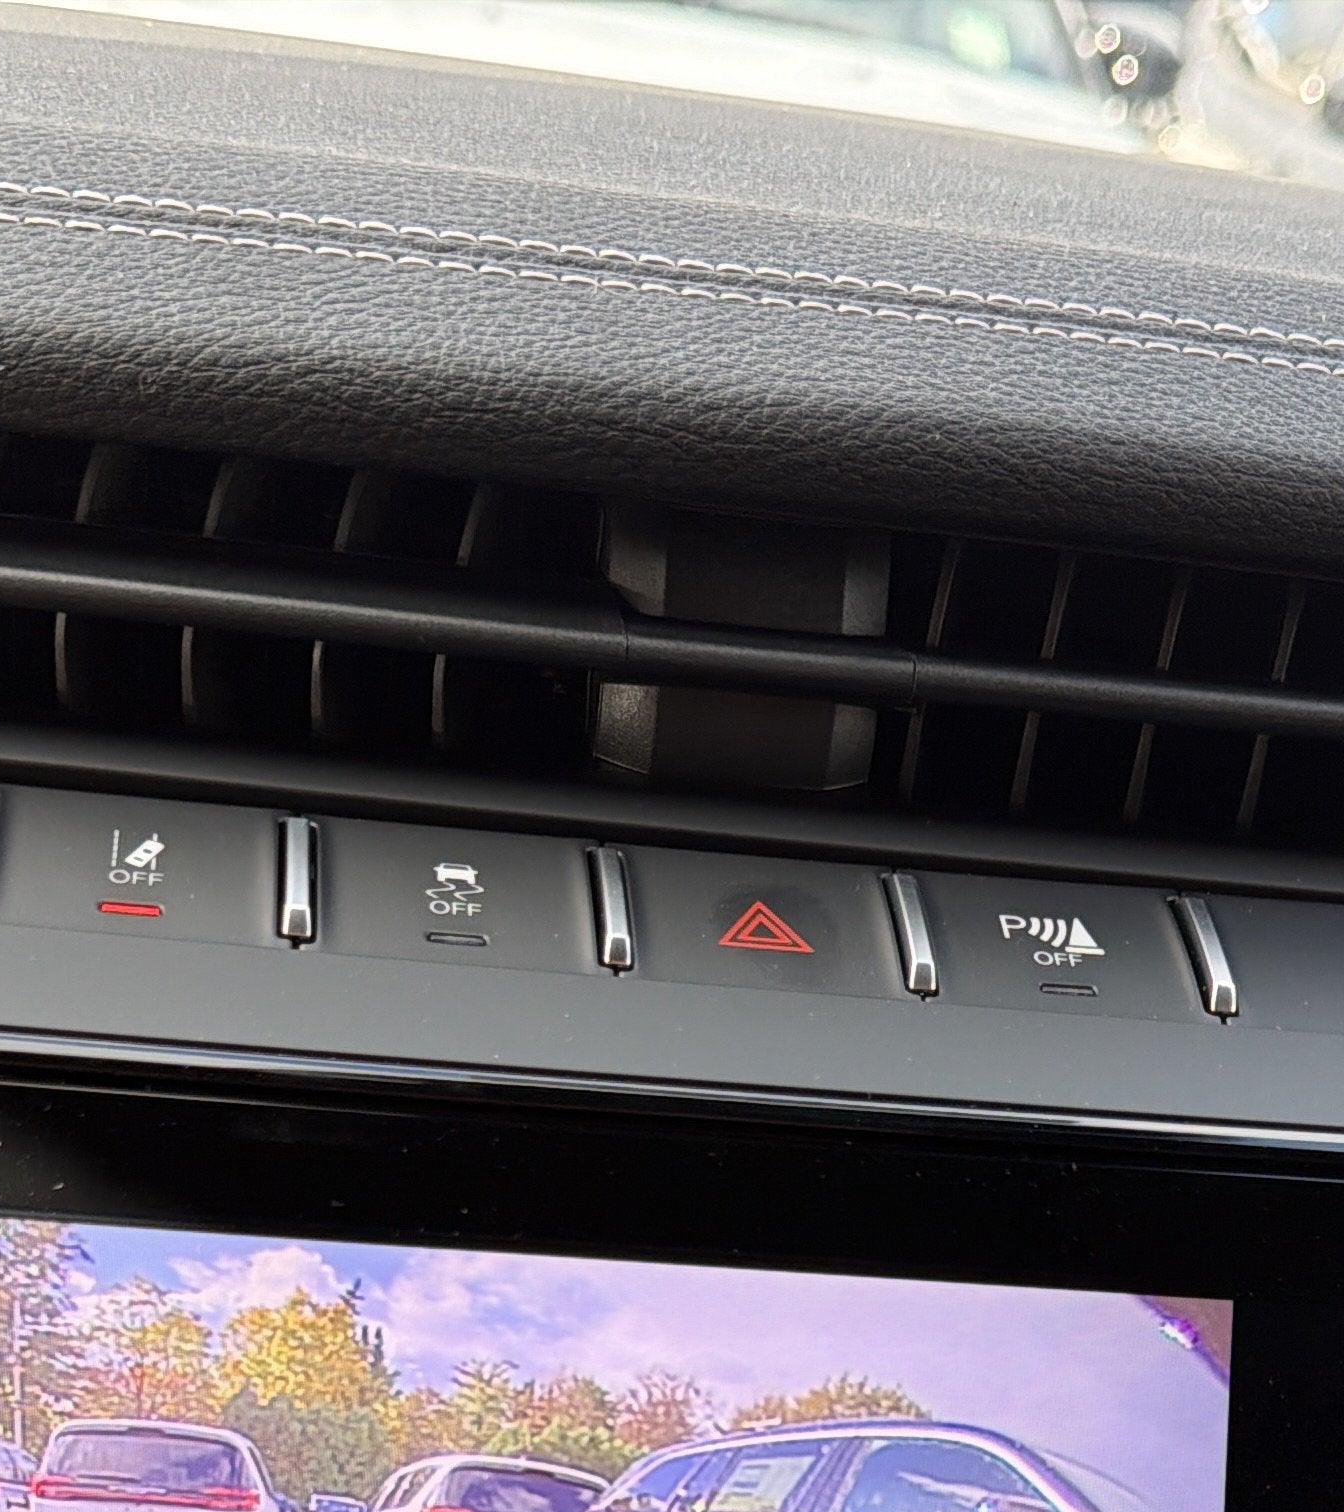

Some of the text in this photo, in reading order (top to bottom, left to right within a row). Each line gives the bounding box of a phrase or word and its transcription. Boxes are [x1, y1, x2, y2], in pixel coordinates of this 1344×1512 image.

[108, 869, 165, 887] OFF
[429, 900, 483, 917] OFF
[1033, 951, 1083, 968] OFF
